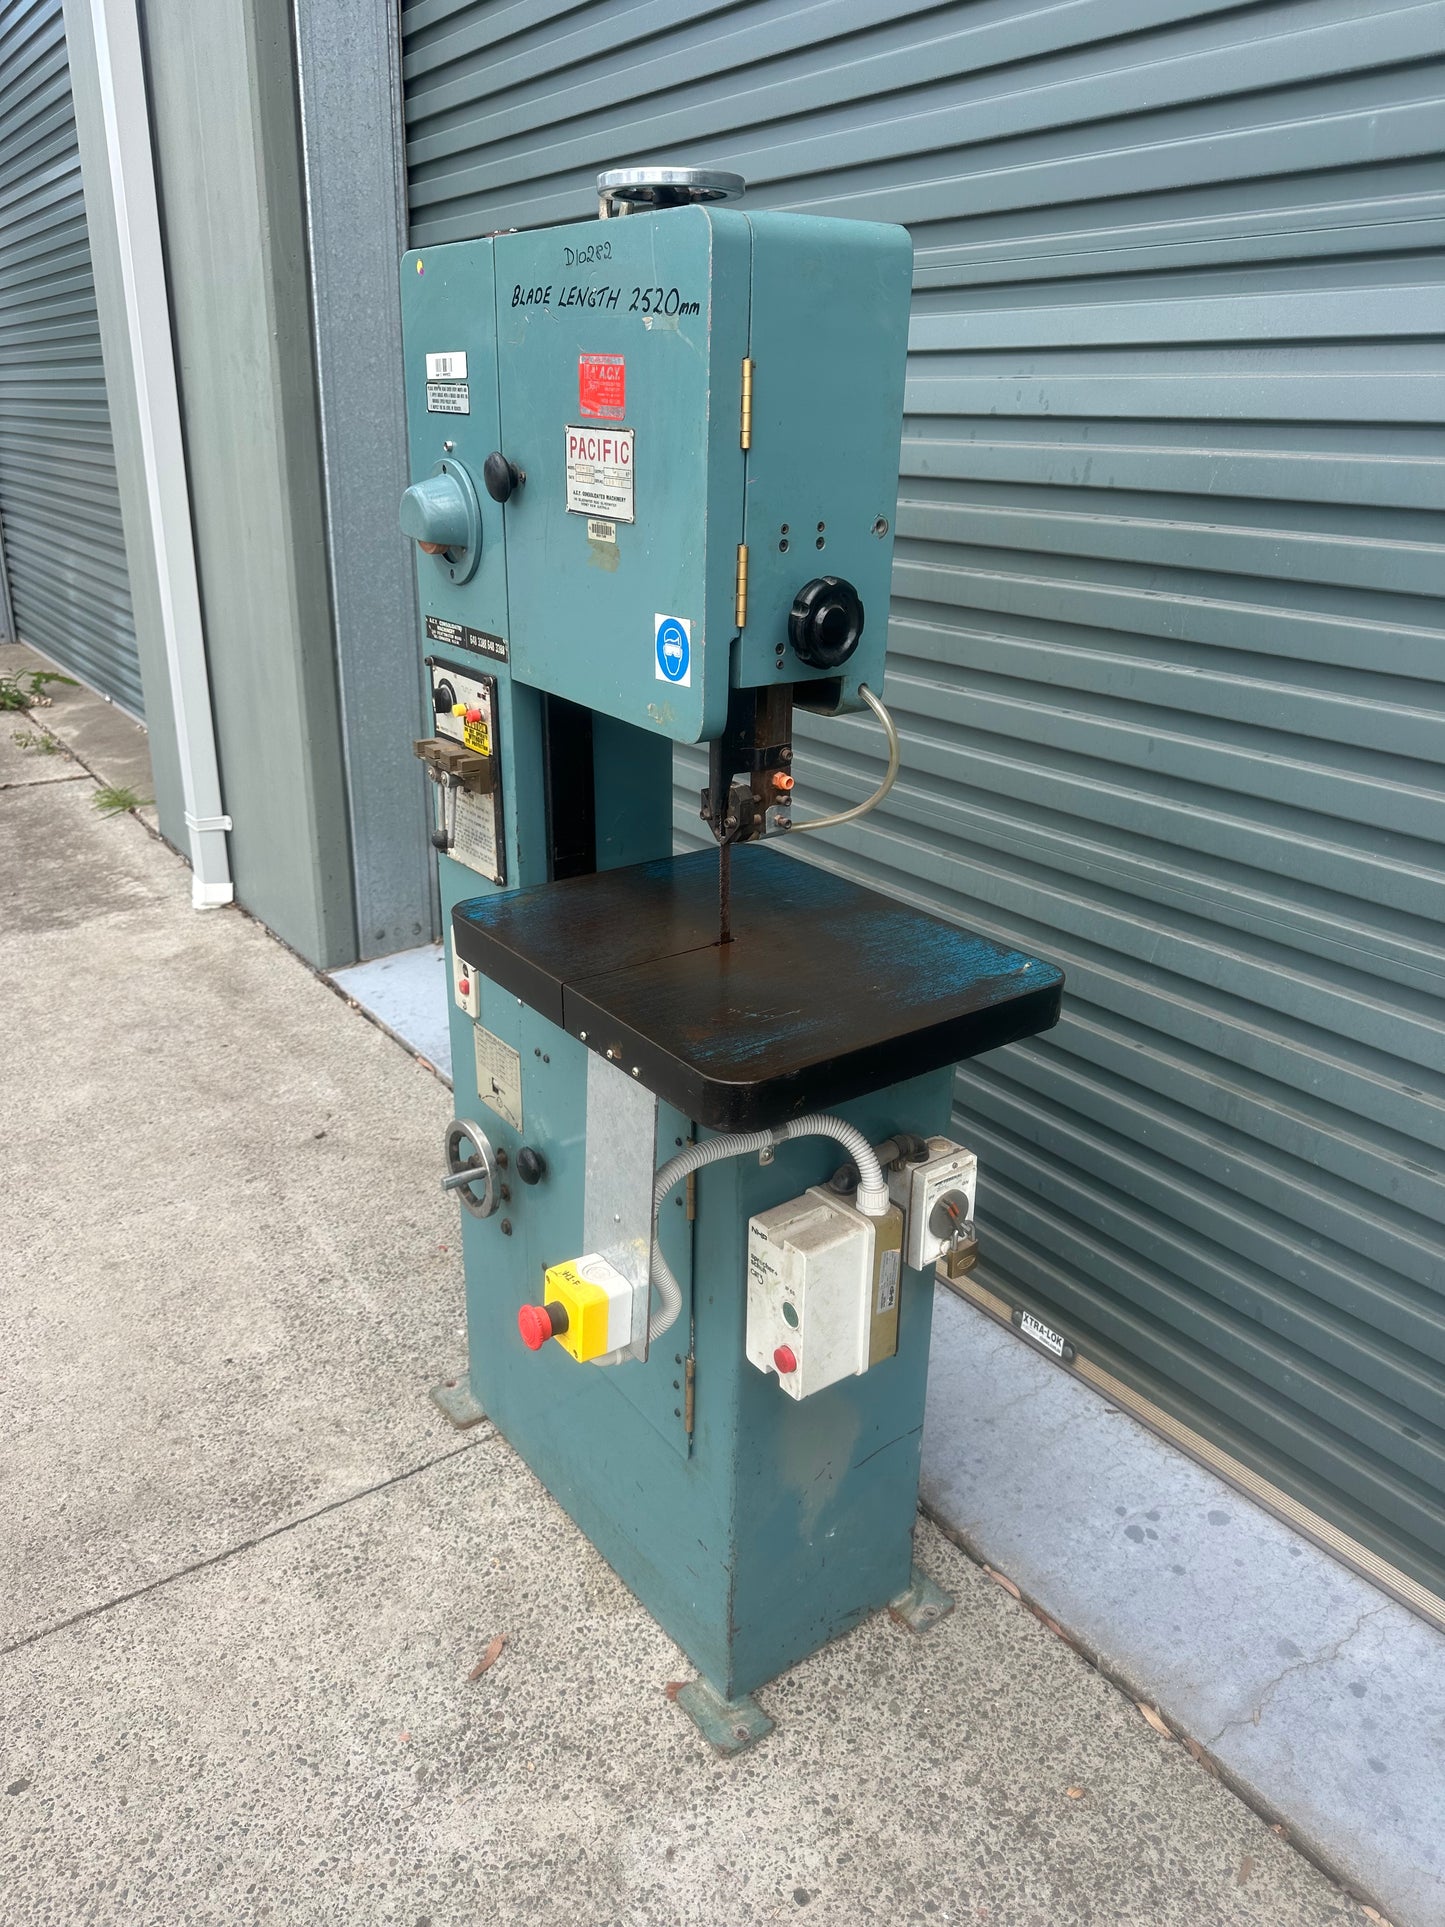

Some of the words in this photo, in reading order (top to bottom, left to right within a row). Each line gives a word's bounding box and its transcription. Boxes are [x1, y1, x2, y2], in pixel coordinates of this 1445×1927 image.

[511, 285, 552, 307] BLADE
[558, 286, 621, 309] LENGTH
[629, 287, 700, 316] 2520mm
[569, 436, 629, 464] PACIFIC
[1023, 1313, 1062, 1347] XTRA-LOK
